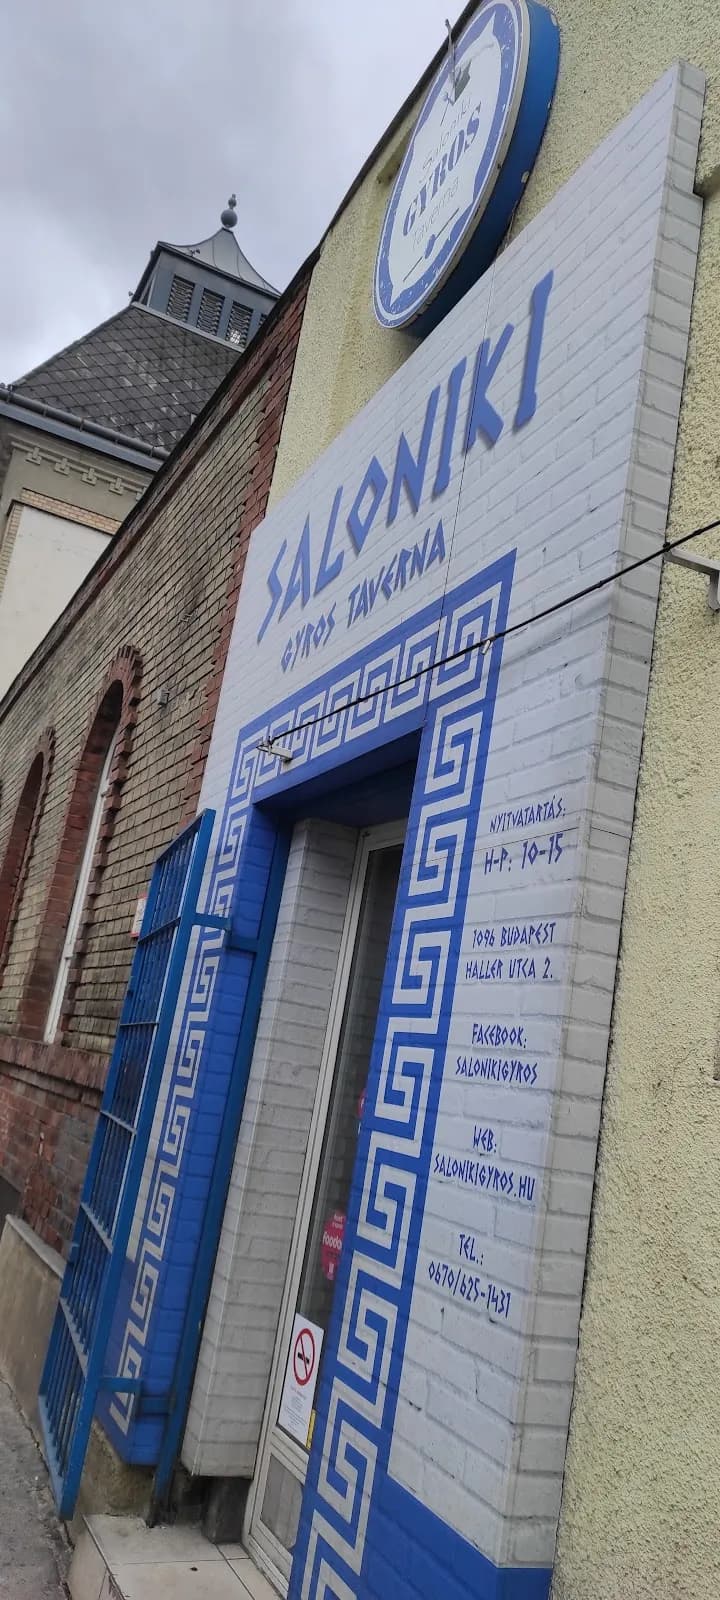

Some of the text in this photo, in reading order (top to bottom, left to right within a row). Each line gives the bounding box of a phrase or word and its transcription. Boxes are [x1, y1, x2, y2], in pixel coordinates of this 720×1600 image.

[403, 101, 482, 236] GYROS
[257, 270, 554, 645] SALONIKI
[281, 518, 446, 673] GYROS TAVERNA
[489, 795, 567, 833] NYITVATARTÁS:
[484, 832, 564, 875] H-P: 10-15
[472, 922, 557, 949] 1096 BUDAPEST
[466, 956, 553, 980] HALLER UTCA 2.
[471, 1023, 527, 1049] FACEBOOK:
[455, 1055, 538, 1085] SALONIKIGYROS
[472, 1125, 497, 1153] WEB:
[433, 1153, 535, 1201] SALONIKIGYROS.HU
[322, 1231, 343, 1251] foodo
[459, 1234, 484, 1266] TEL.:
[428, 1260, 512, 1319] 0670/625-1431
